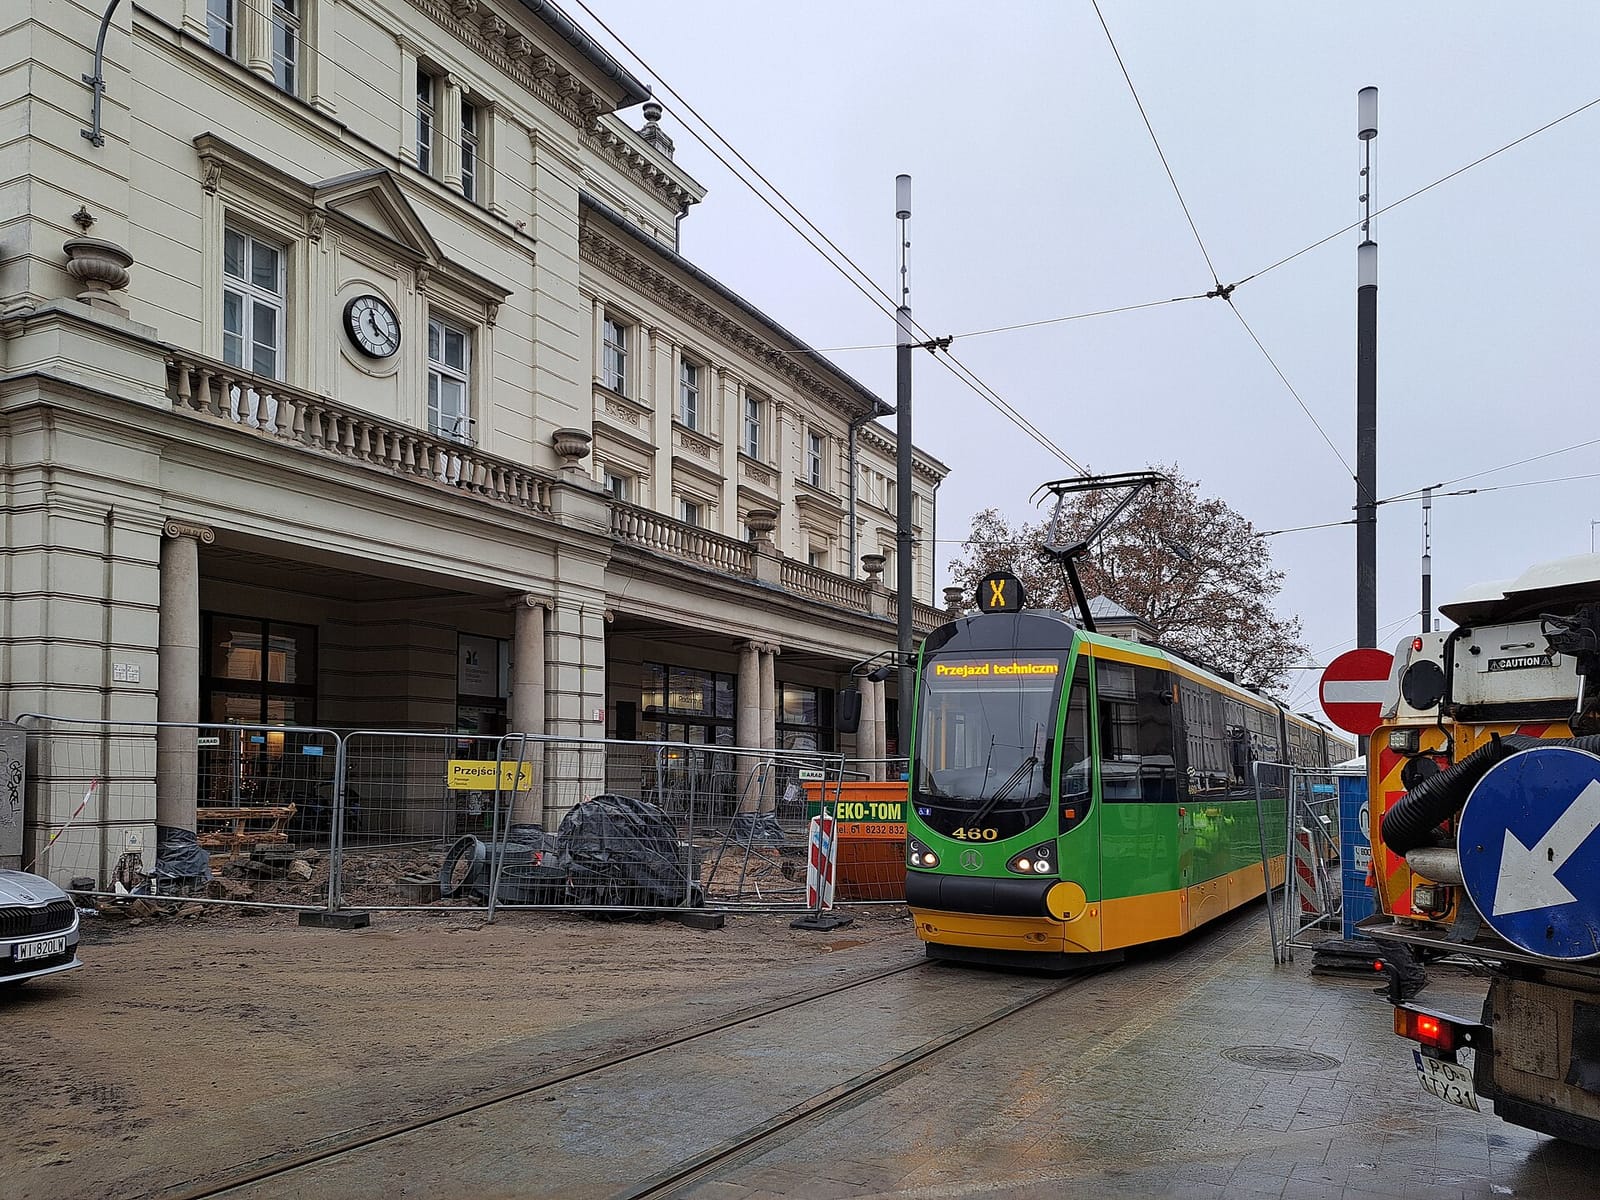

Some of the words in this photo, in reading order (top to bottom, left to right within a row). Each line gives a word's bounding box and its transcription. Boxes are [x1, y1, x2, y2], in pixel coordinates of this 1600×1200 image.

[989, 579, 1006, 607] X
[1500, 656, 1540, 668] CAUTION
[936, 663, 989, 677] Przejazd
[454, 766, 501, 776] Przejści
[836, 802, 901, 820] EKO-TOM
[865, 825, 886, 834] 8232
[888, 825, 904, 835] 832
[952, 827, 998, 840] 460
[20, 943, 32, 958] WI
[1428, 1059, 1455, 1081] PO
[1421, 1074, 1477, 1111] 1TX31
